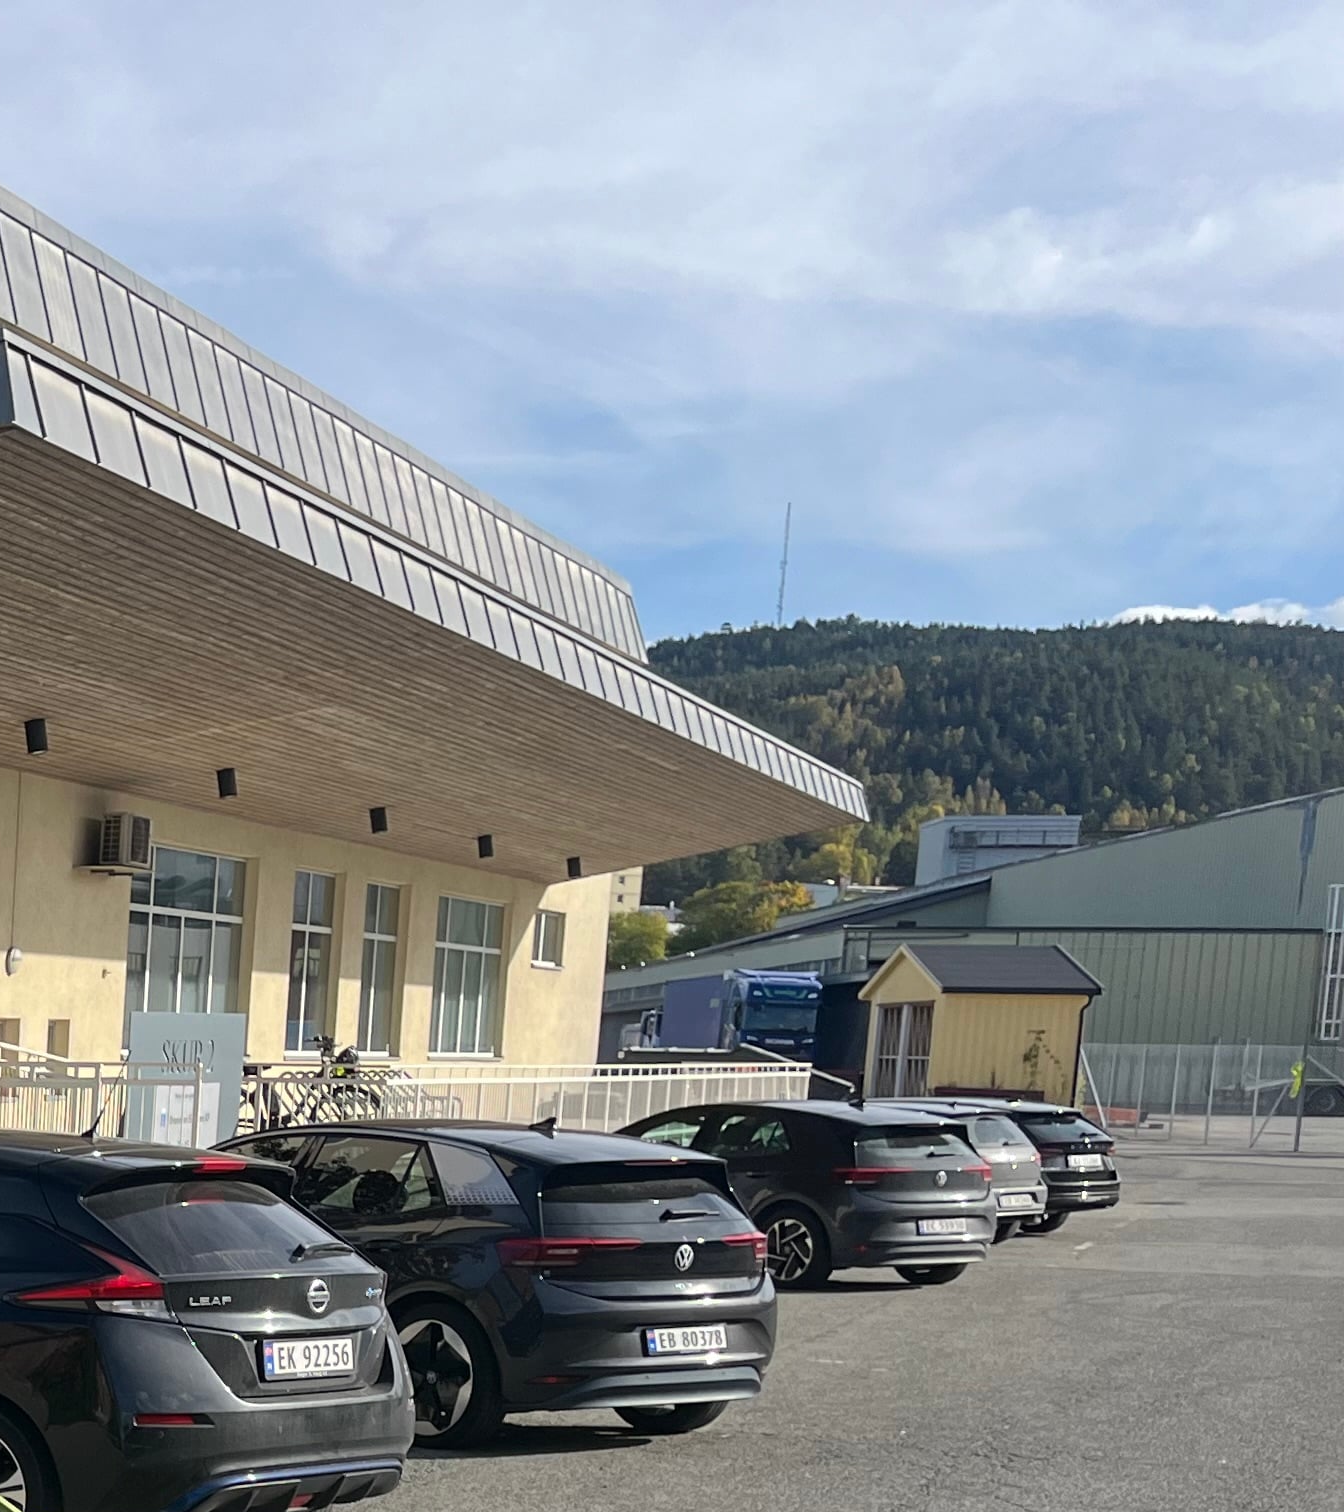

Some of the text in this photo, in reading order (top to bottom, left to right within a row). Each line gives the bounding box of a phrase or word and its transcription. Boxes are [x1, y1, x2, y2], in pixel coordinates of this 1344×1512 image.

[658, 1329, 723, 1349] EB 80378
[277, 1342, 350, 1370] EK 92256
